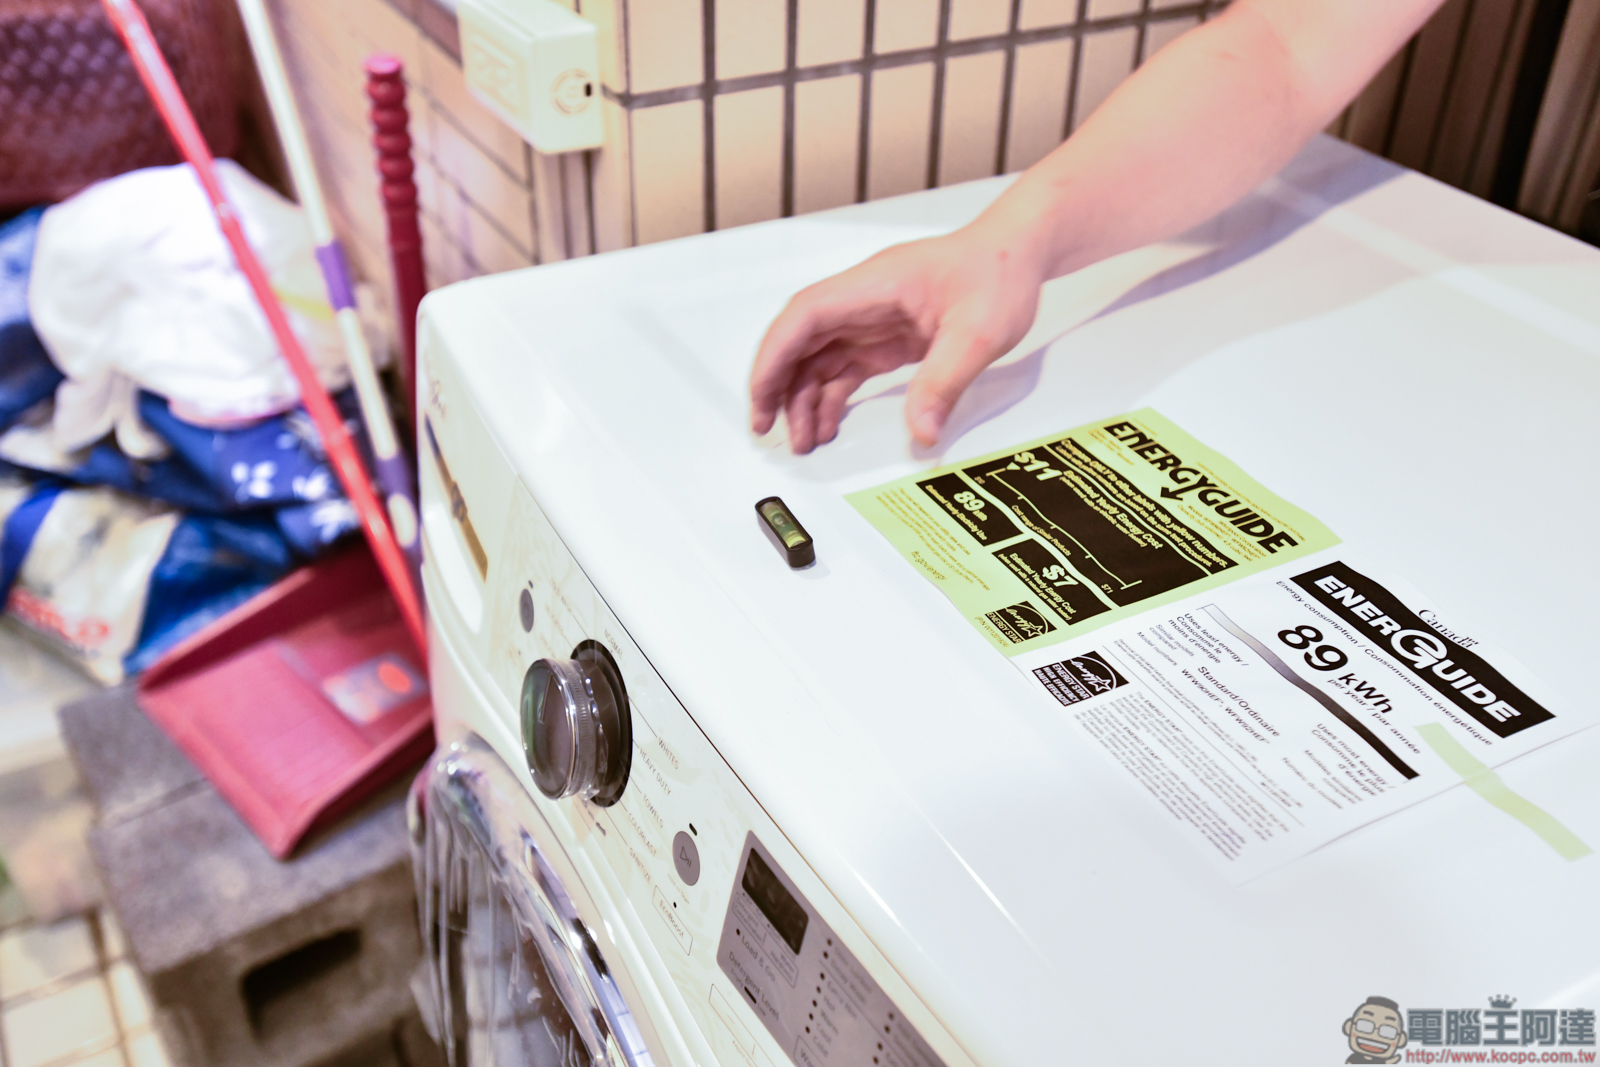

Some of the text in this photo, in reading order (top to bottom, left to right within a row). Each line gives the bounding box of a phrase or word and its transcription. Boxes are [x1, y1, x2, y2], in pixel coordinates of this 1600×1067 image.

[1010, 450, 1062, 480] $11
[954, 491, 984, 511] 89
[1057, 438, 1091, 462] Compare
[1115, 480, 1136, 496] other
[1133, 495, 1156, 511] labels
[1154, 510, 1171, 524] with
[1166, 523, 1195, 540] yellow
[1192, 540, 1227, 567] numbers.
[1103, 421, 1299, 554] ENERGYGUIDE
[925, 485, 948, 504] Estimated
[956, 513, 979, 532] Electricity
[976, 530, 987, 540] Use
[1061, 470, 1163, 549] Estimated Yearly Energy Cost
[1011, 505, 1024, 516] Cost
[1051, 538, 1071, 556] Products
[1170, 533, 1183, 543] test
[1178, 542, 1212, 567] procedures.
[1010, 553, 1076, 614] Estimated Yearly Energy Cost
[1042, 565, 1078, 586] $7
[1101, 584, 1113, 593] $71
[1046, 598, 1058, 608] water
[1056, 607, 1072, 620] heater)
[604, 629, 623, 659] NORMAL
[984, 611, 1021, 643] ENERGY STAR
[1156, 624, 1194, 656] Similar models
[1168, 619, 1189, 638] moins
[1177, 616, 1214, 647] Consomme
[1184, 613, 1201, 629] Uses
[1201, 629, 1219, 642] least
[1218, 642, 1243, 662] energy
[1414, 609, 1478, 649] Canada
[1137, 631, 1178, 666] Model numbers
[1276, 581, 1304, 602] Energy
[1304, 603, 1358, 644] consumption
[1365, 649, 1432, 701] Consommation
[1434, 702, 1492, 745] énergétique
[1313, 575, 1521, 722] ENERGUIDE
[1034, 669, 1051, 684] HAUTE
[1043, 667, 1079, 701] HIGH EFFICIENCY
[1052, 664, 1089, 699] ENERGY STAR
[1278, 625, 1392, 713] 89 kWh
[1144, 700, 1165, 718] ENERGY
[1198, 667, 1279, 736] Standard/Ordinaire
[1327, 679, 1346, 689] per
[1344, 690, 1367, 705] year
[1371, 712, 1390, 725] par
[1390, 728, 1420, 754] année
[658, 737, 679, 770] WHITES
[1312, 729, 1384, 793] Consomme le plus
[1317, 723, 1333, 736] Uses
[1338, 741, 1360, 759] most
[1359, 760, 1387, 785] energy
[640, 748, 672, 796] HEAVY DUTY
[643, 794, 664, 828] TOWELS
[629, 848, 652, 884] SANITIZE
[741, 934, 758, 960] Load
[728, 951, 779, 1021] Detergent Level
